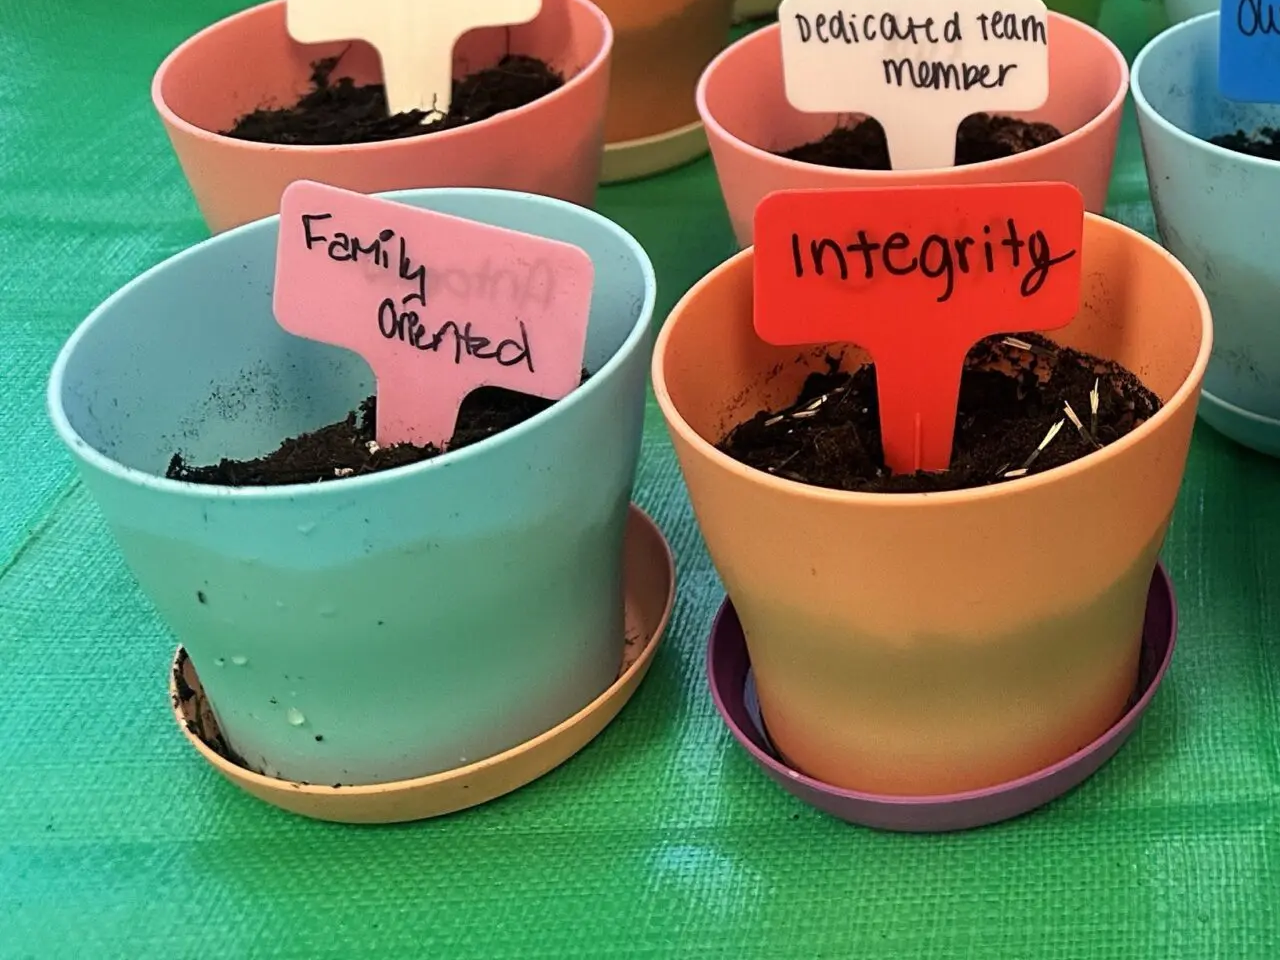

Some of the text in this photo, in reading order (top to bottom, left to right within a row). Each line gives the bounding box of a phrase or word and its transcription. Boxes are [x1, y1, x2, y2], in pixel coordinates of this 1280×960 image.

[794, 10, 963, 45] Dedicated
[301, 212, 427, 307] Family
[791, 217, 1077, 303] Integrity
[377, 297, 535, 373] Oriented
